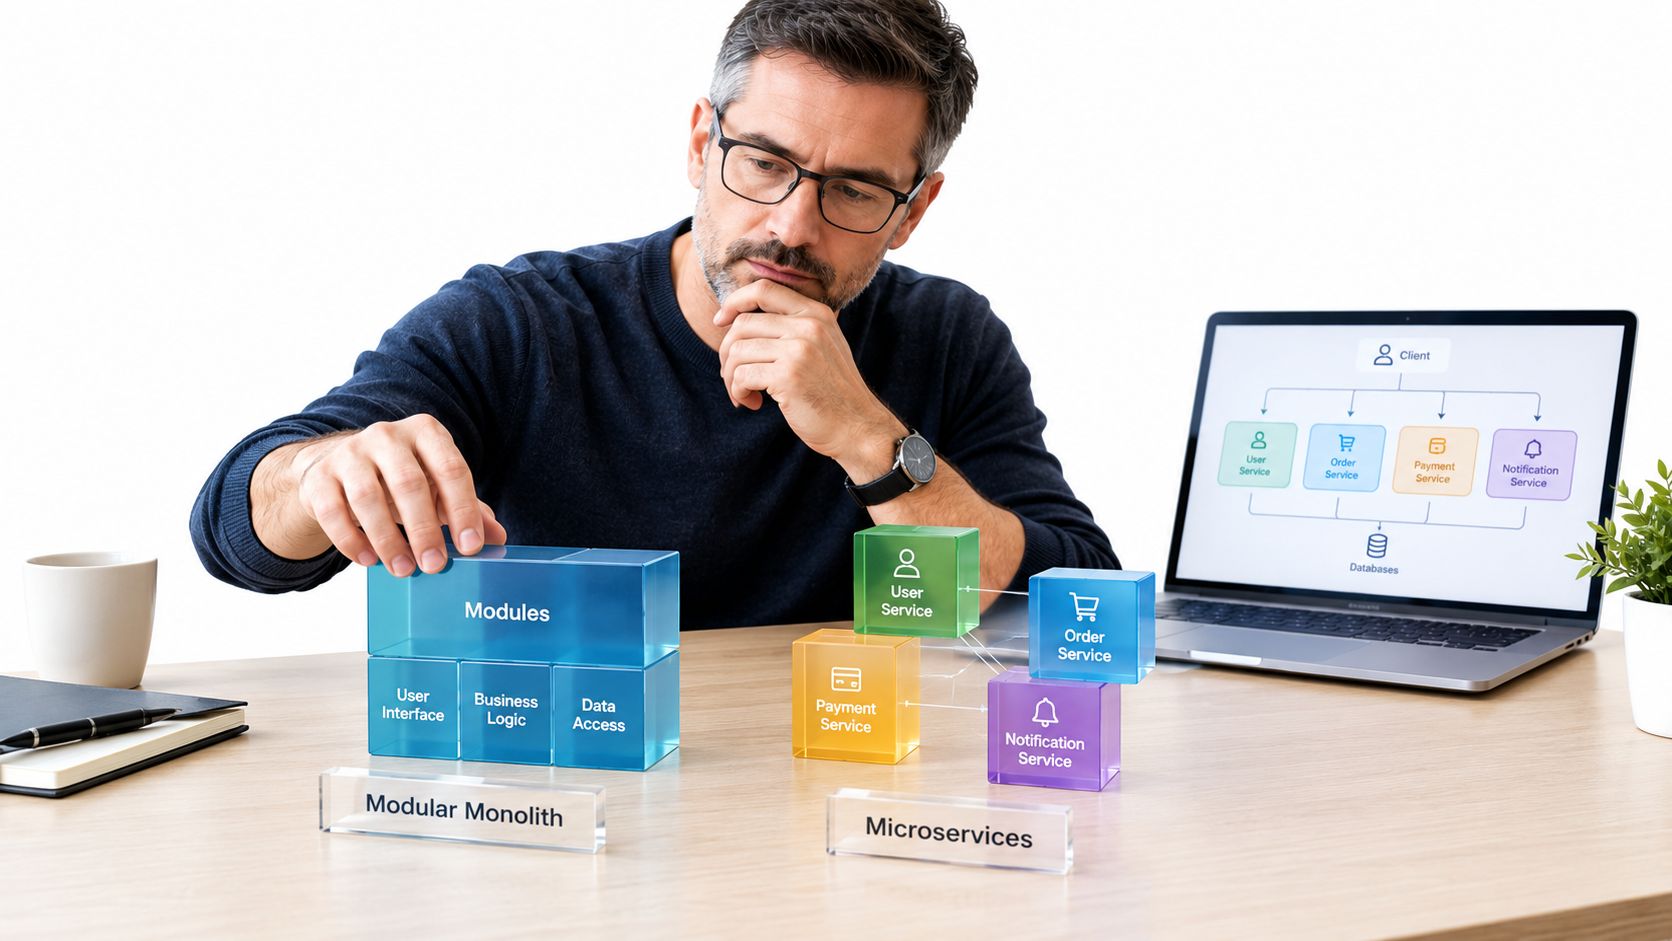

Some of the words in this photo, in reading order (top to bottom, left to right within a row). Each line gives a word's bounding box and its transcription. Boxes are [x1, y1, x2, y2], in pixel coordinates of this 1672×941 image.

[1399, 350, 1431, 361] Client
[1245, 455, 1267, 465] User
[1330, 457, 1356, 469] Order
[1414, 460, 1456, 473] Payment
[1239, 466, 1271, 477] Service
[1324, 469, 1359, 481] Service
[1502, 463, 1560, 476] Notification
[1415, 473, 1451, 485] Service
[1510, 477, 1547, 488] Service
[1349, 562, 1399, 575] Databases
[890, 585, 924, 599] User
[464, 602, 551, 622] Modules
[880, 602, 933, 618] Service
[1064, 628, 1105, 644] Order
[1057, 647, 1112, 663] Service
[396, 687, 430, 703] User
[474, 692, 539, 709] Business
[581, 698, 616, 713] Data
[816, 699, 876, 717] Payment
[381, 706, 445, 722] Interface
[487, 711, 527, 729] Logic
[572, 716, 626, 732] Access
[820, 718, 872, 734] Service
[1005, 732, 1085, 751] Notification
[1018, 752, 1073, 768] Service
[366, 793, 458, 818] Modular
[465, 801, 563, 827] Monolith
[866, 816, 1034, 848] Microservices
